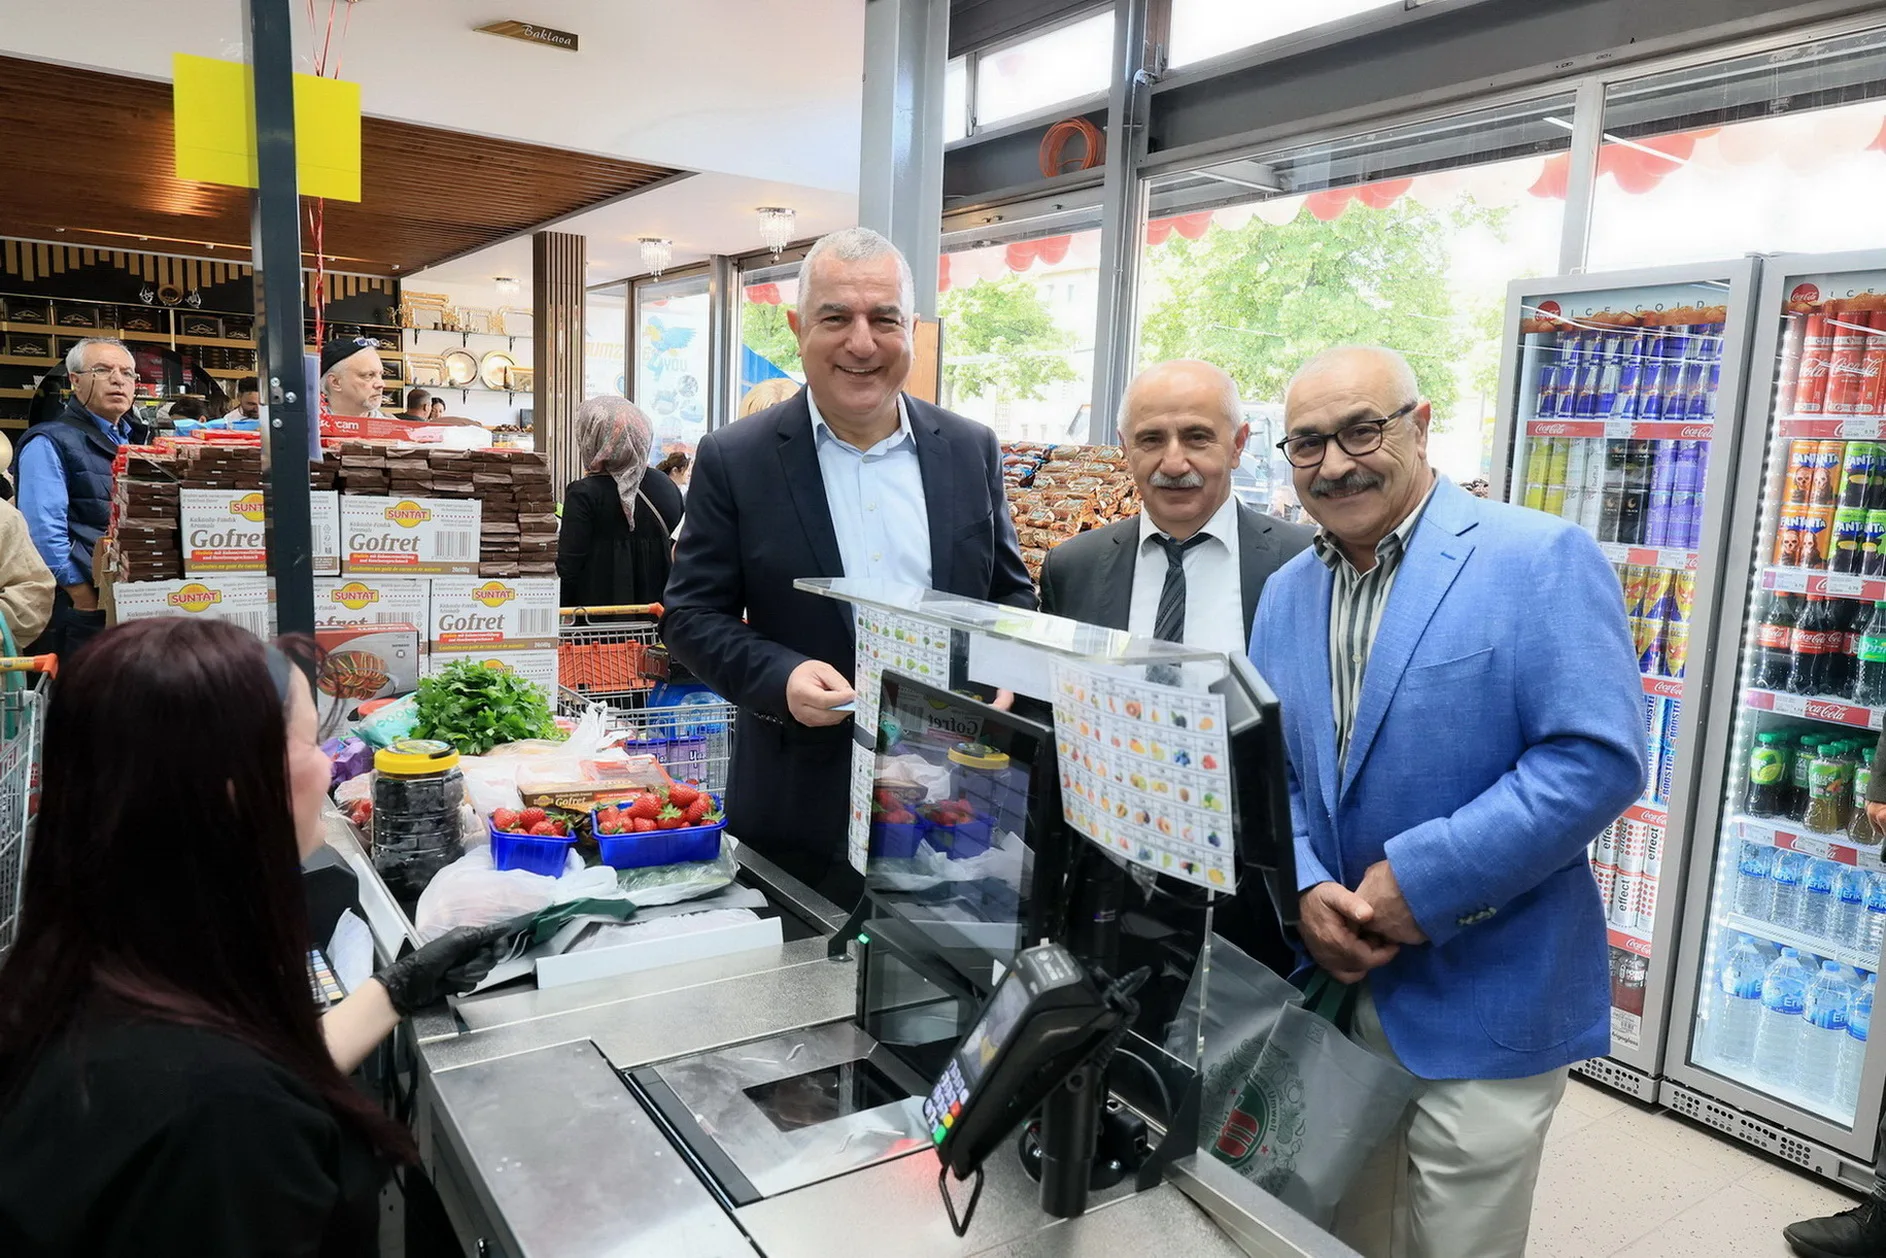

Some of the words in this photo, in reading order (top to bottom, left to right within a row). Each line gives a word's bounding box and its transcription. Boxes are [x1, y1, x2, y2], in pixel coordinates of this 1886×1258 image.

[522, 25, 571, 45] Baklava
[234, 503, 264, 512] SUNT
[388, 509, 428, 519] SUNTAT
[349, 533, 420, 552] Gofret
[172, 592, 218, 604] SUNTAT
[335, 592, 375, 600] SUNTAT
[475, 590, 511, 598] SUNTAT
[439, 614, 505, 631] Gofret
[1648, 828, 1659, 860] effect
[1619, 880, 1630, 912] effect
